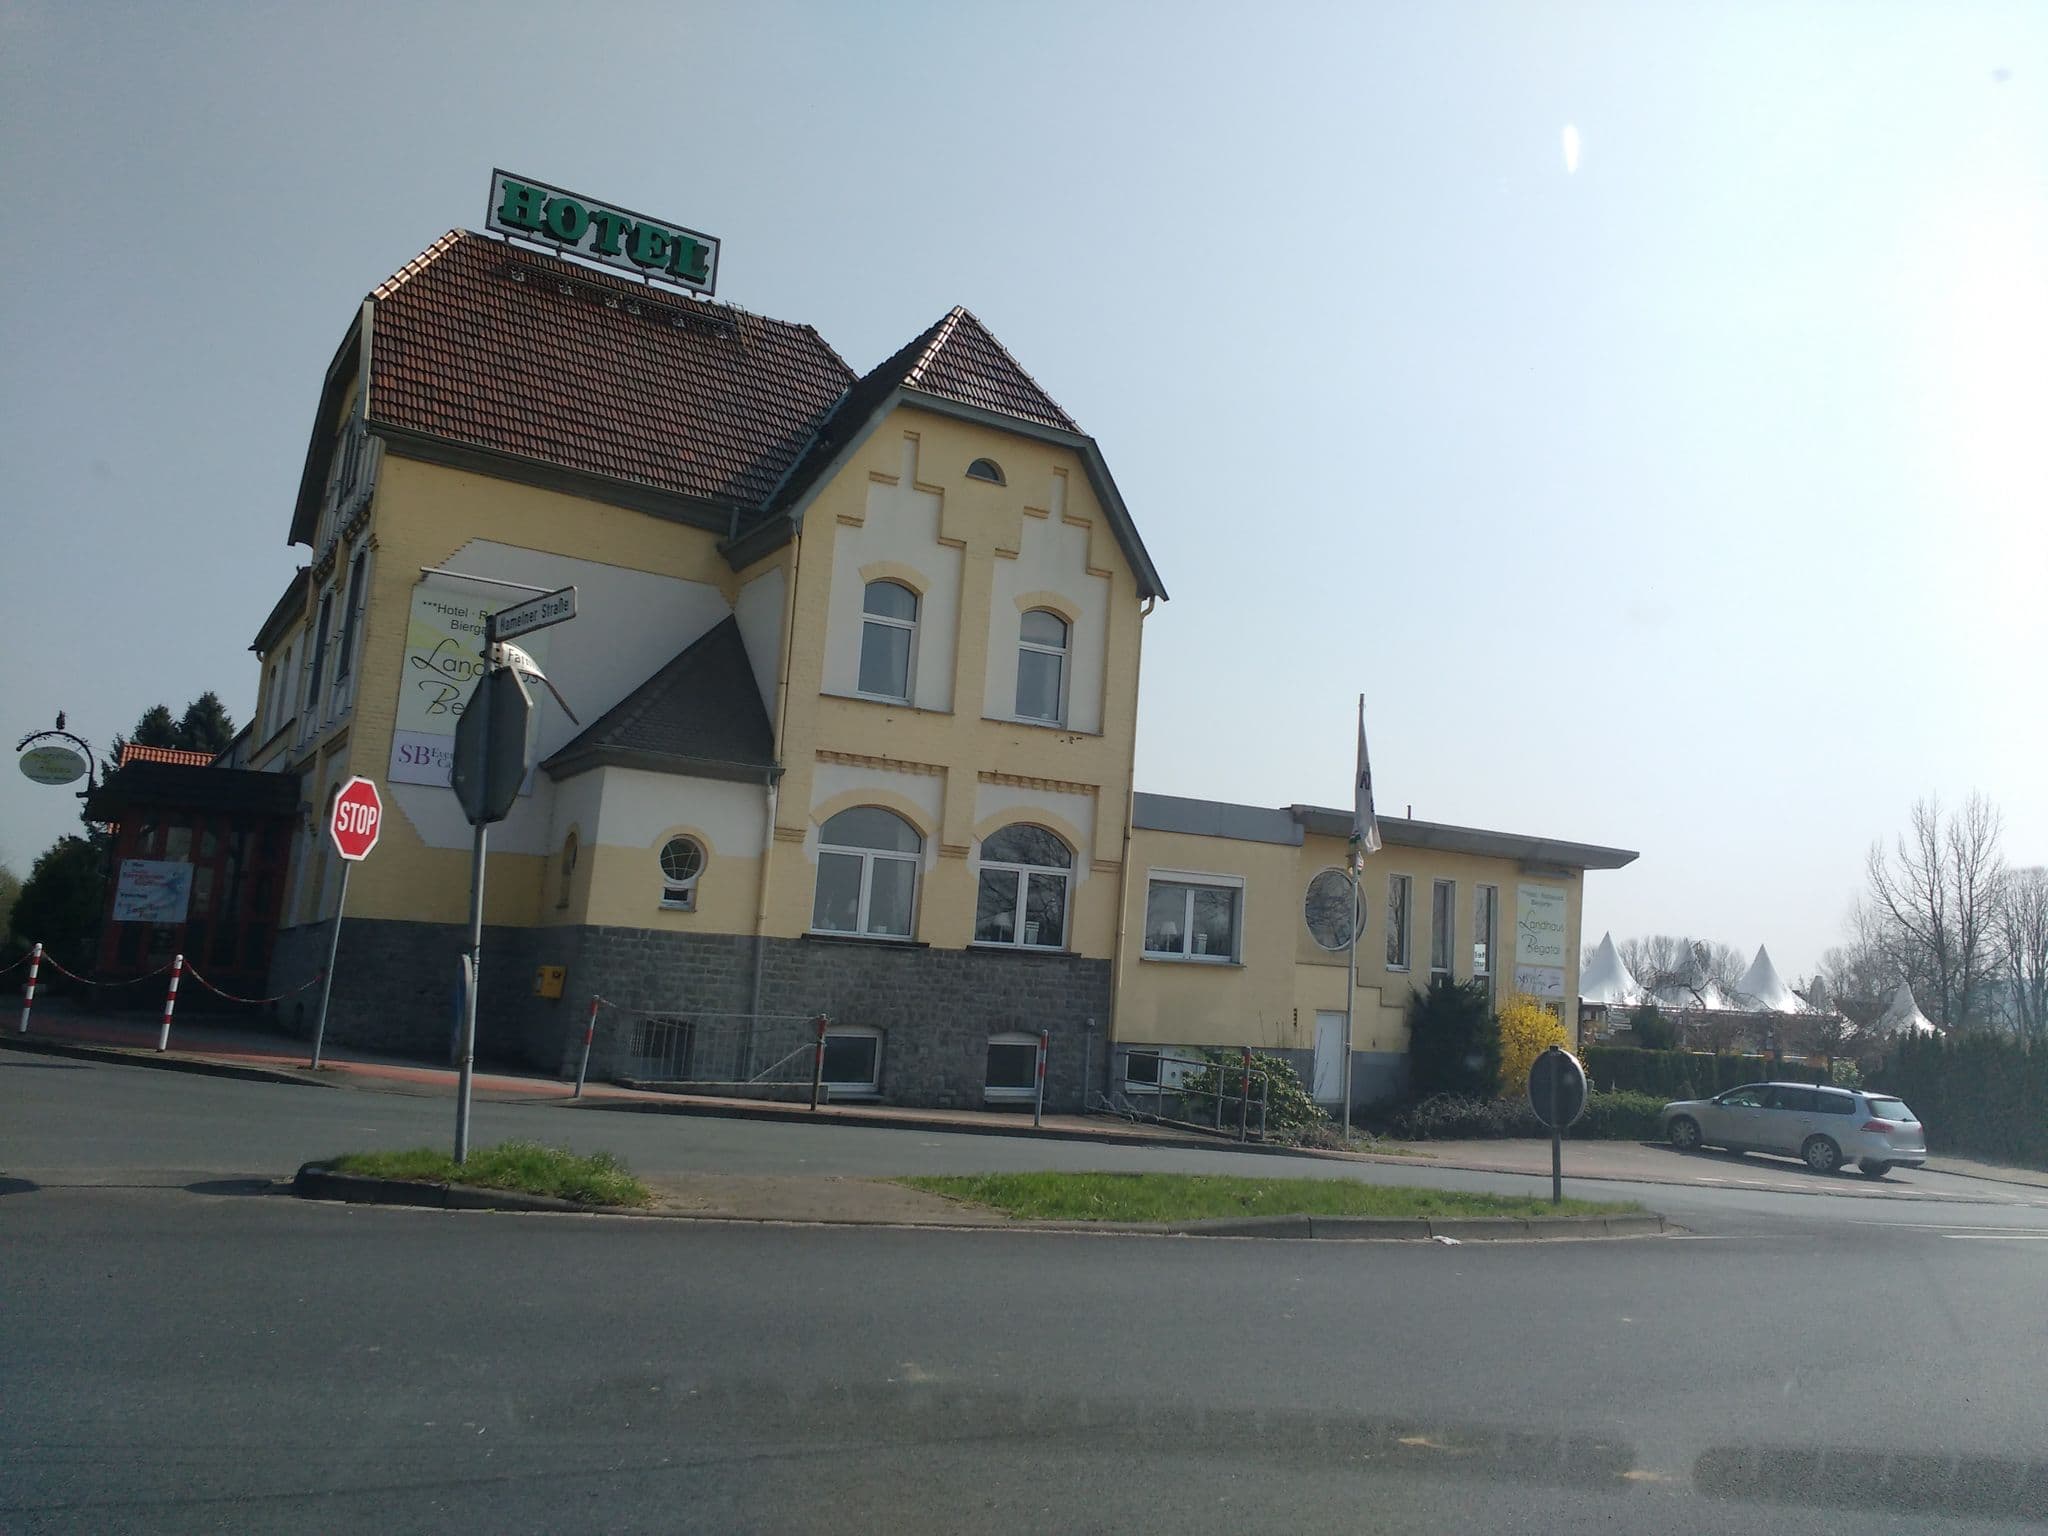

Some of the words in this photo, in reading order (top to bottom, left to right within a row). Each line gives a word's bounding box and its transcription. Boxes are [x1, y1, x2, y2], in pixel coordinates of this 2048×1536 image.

[497, 179, 710, 285] HOTEL
[500, 609, 538, 632] Hamelner
[541, 597, 569, 618] Straße
[398, 744, 430, 765] SB
[337, 801, 377, 835] STOP
